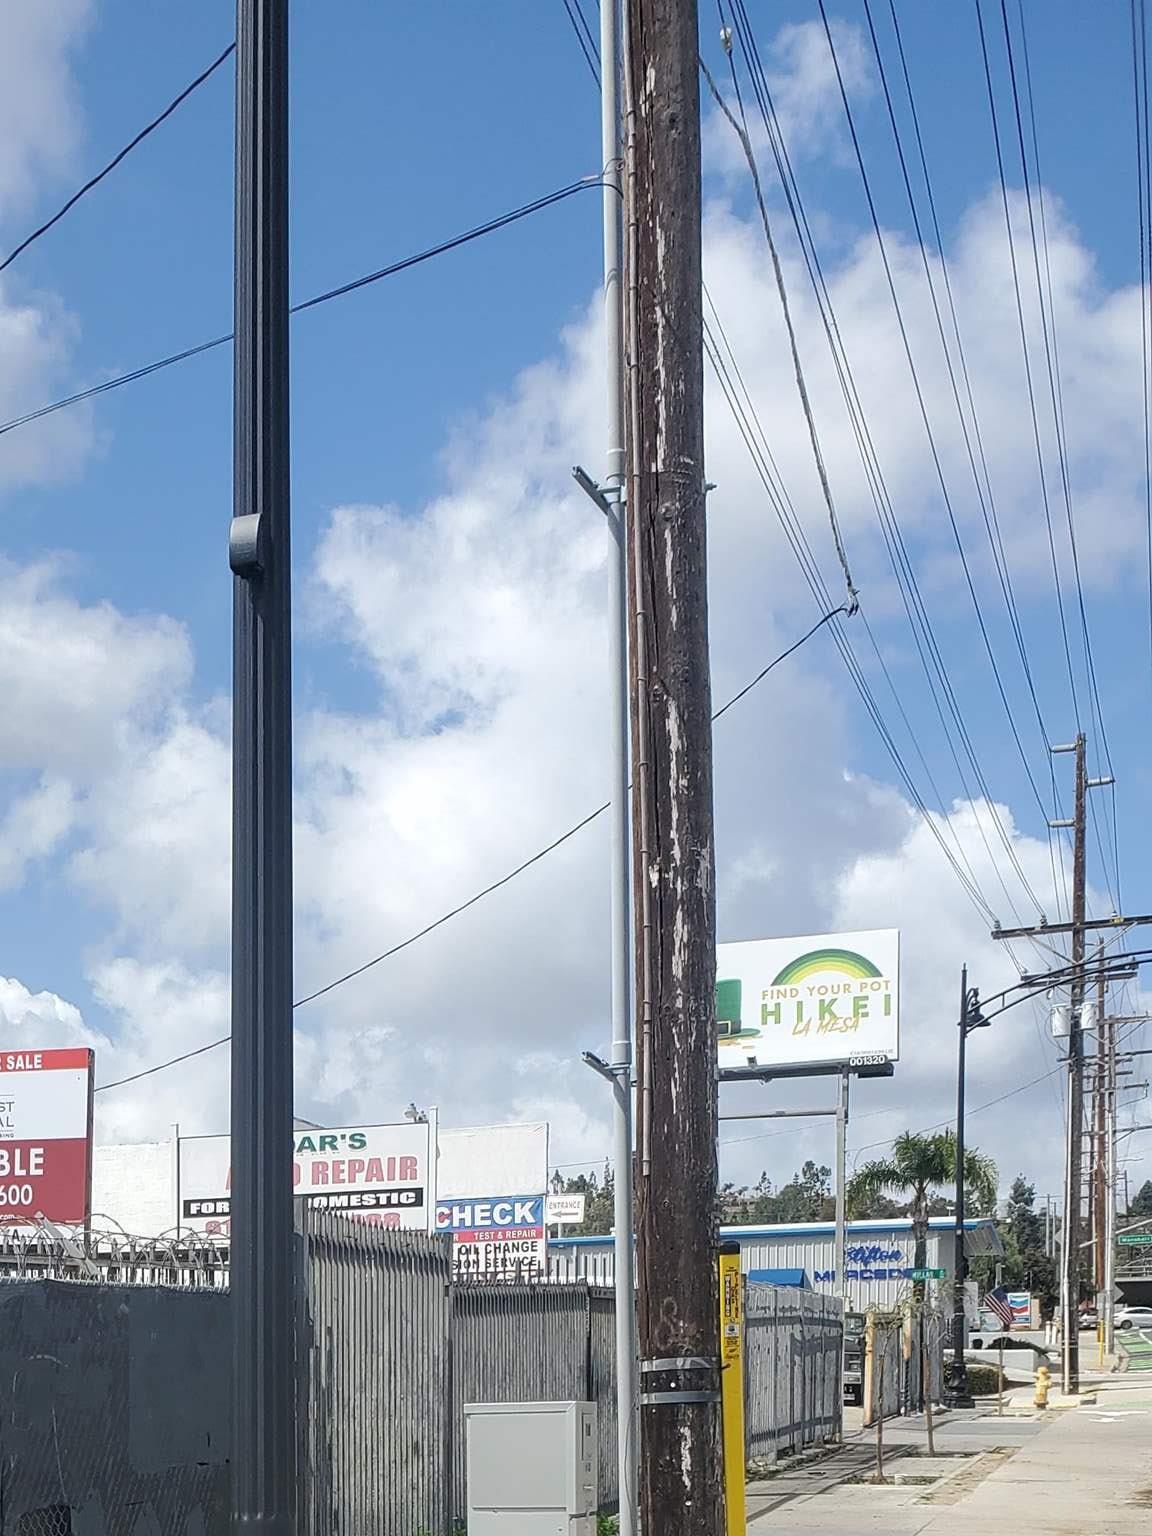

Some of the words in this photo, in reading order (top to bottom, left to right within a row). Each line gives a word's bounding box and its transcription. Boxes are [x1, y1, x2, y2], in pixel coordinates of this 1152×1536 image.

[762, 987, 799, 1000] FIND
[806, 984, 852, 996] YOUR
[859, 980, 891, 993] POT
[760, 994, 891, 1026] HIKEI
[6, 1054, 42, 1070] SALE
[849, 1055, 886, 1067] 001320
[311, 1156, 418, 1185] REPAIR
[548, 1201, 581, 1209] ENTRANCE
[436, 1200, 536, 1229] CHECK
[474, 1231, 495, 1240] TEST
[505, 1229, 536, 1239] REPAIR
[485, 1241, 538, 1255] CHANGE
